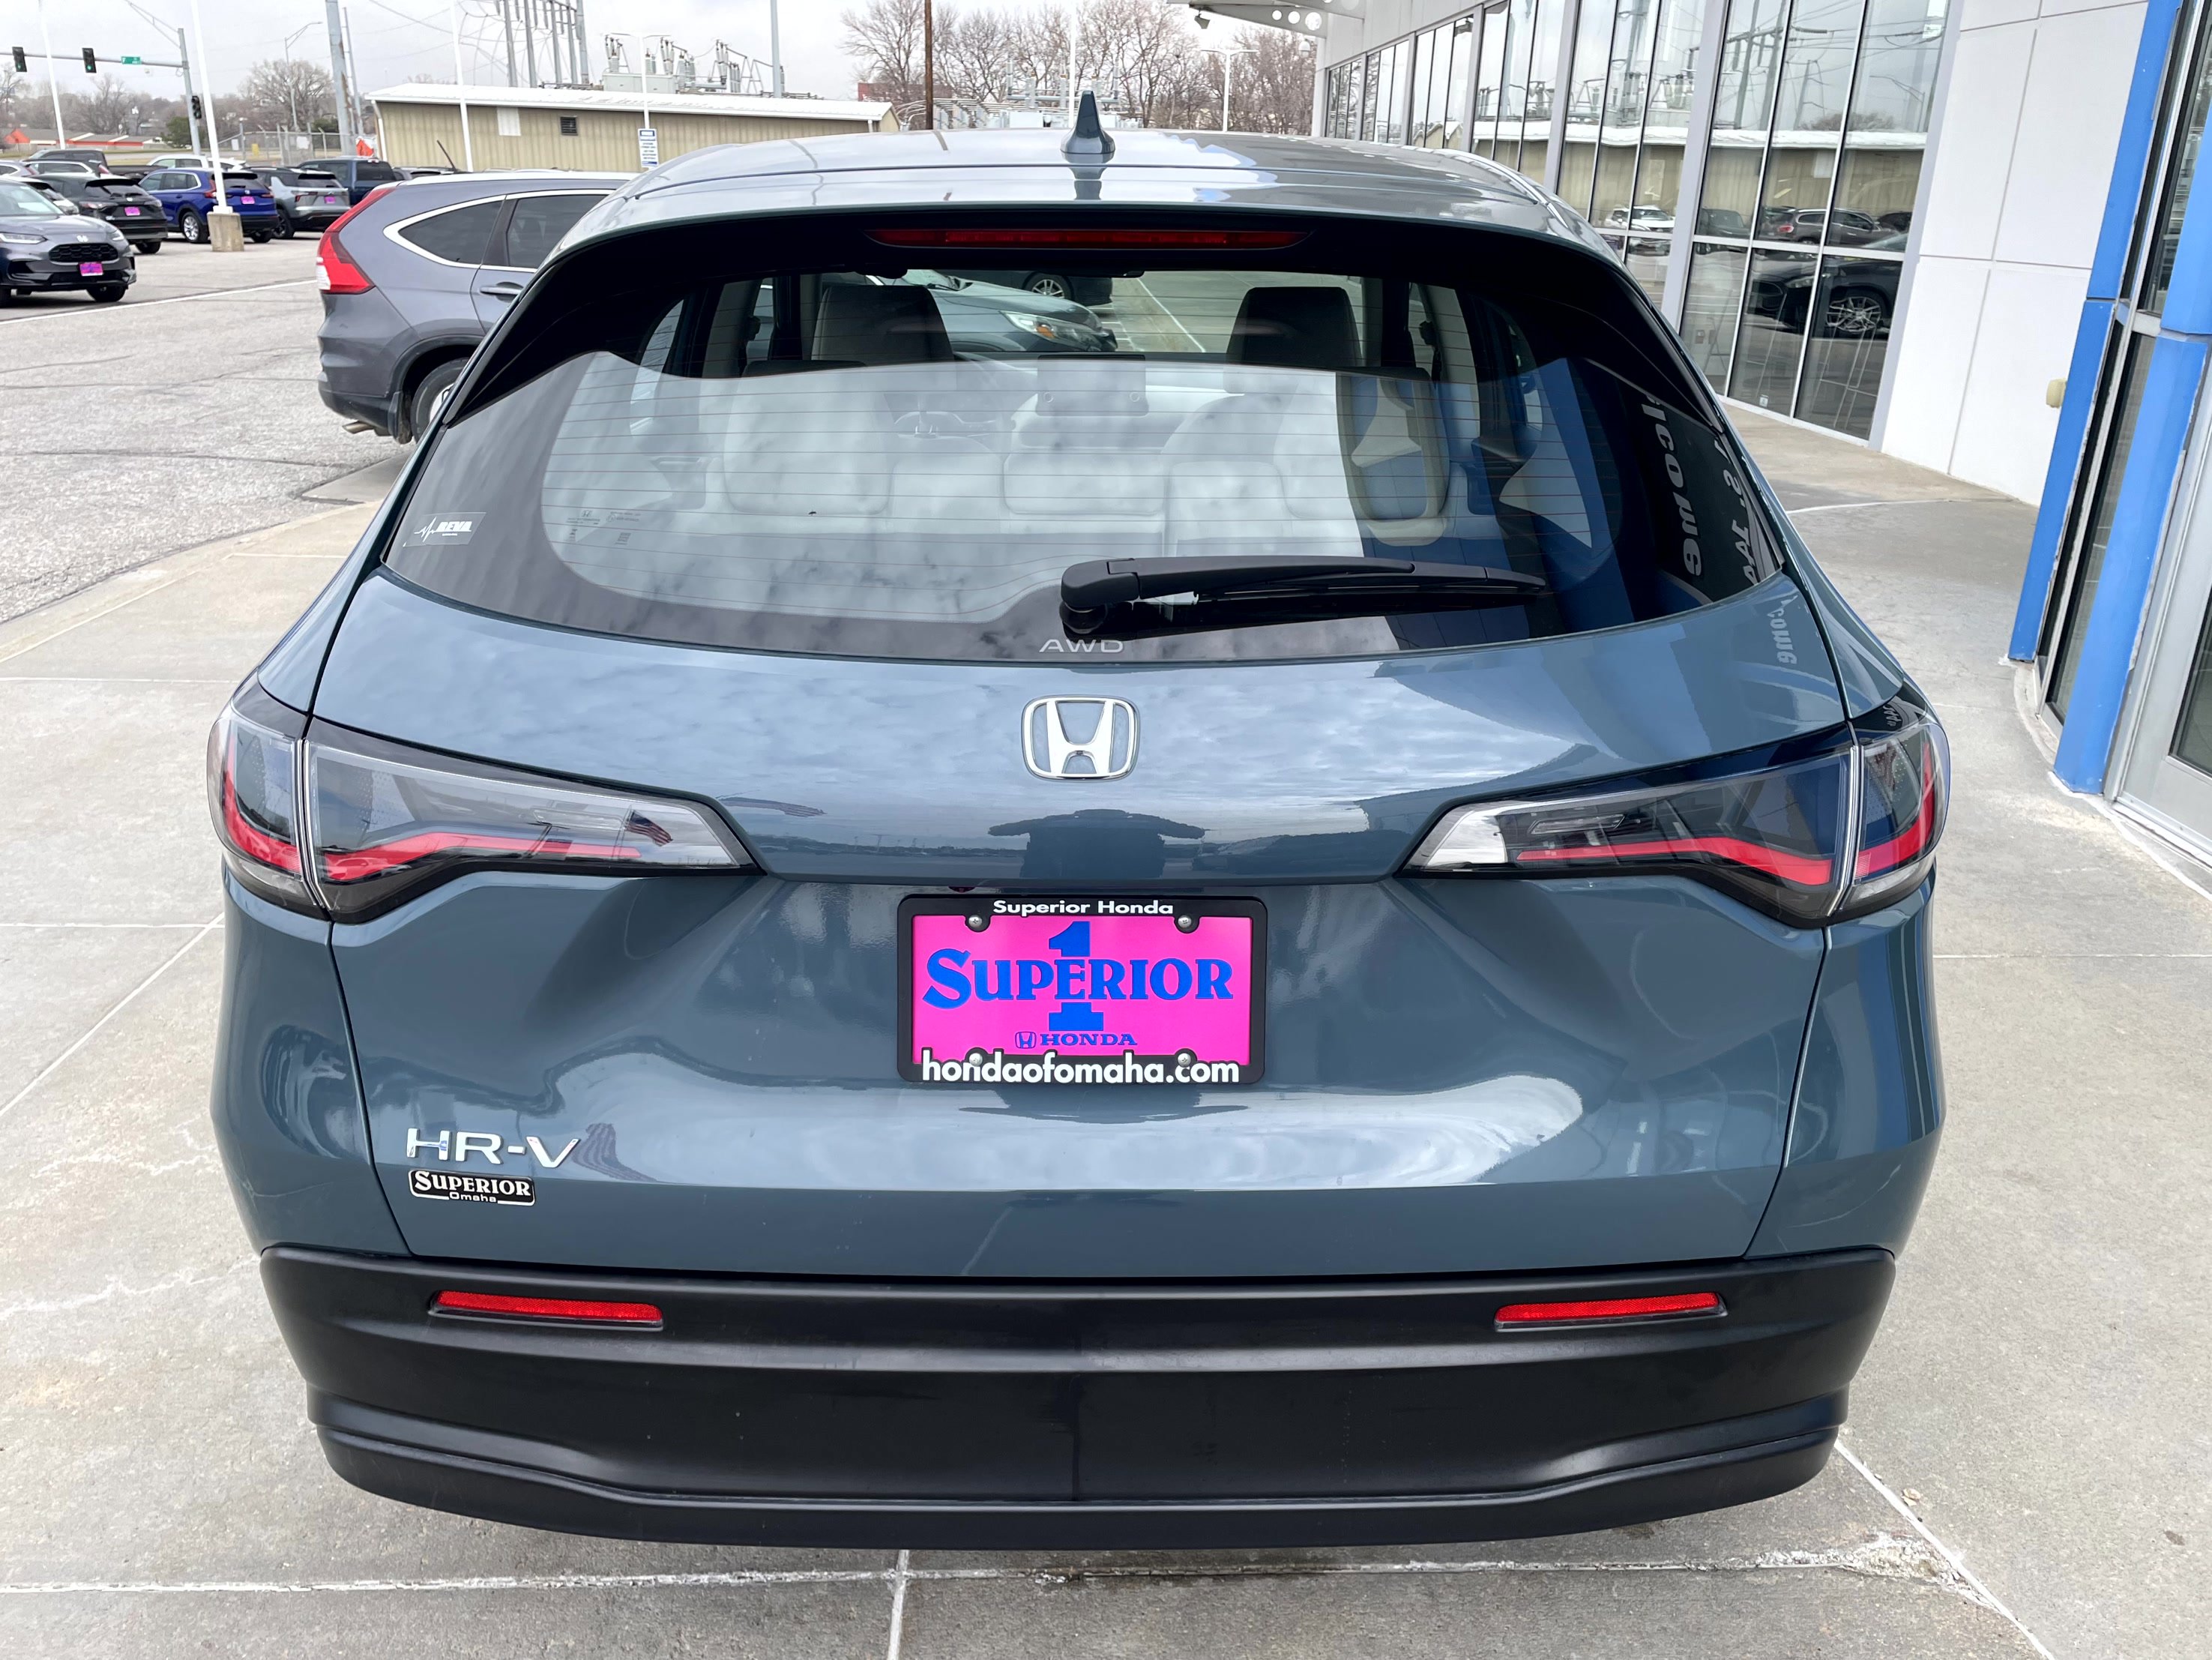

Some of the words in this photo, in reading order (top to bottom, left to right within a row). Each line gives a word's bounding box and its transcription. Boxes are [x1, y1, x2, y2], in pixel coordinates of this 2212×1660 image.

[1039, 639, 1124, 653] AWD
[993, 900, 1091, 917] Superior
[1098, 900, 1174, 915] Honda
[922, 948, 1234, 1009] SUPERIOR
[1040, 1033, 1138, 1046] HONDA
[922, 1050, 1239, 1084] hondaofomaha.com
[406, 1128, 581, 1168] HR-V
[415, 1170, 531, 1197] SUPERIOR
[449, 1191, 498, 1203] Omaha
